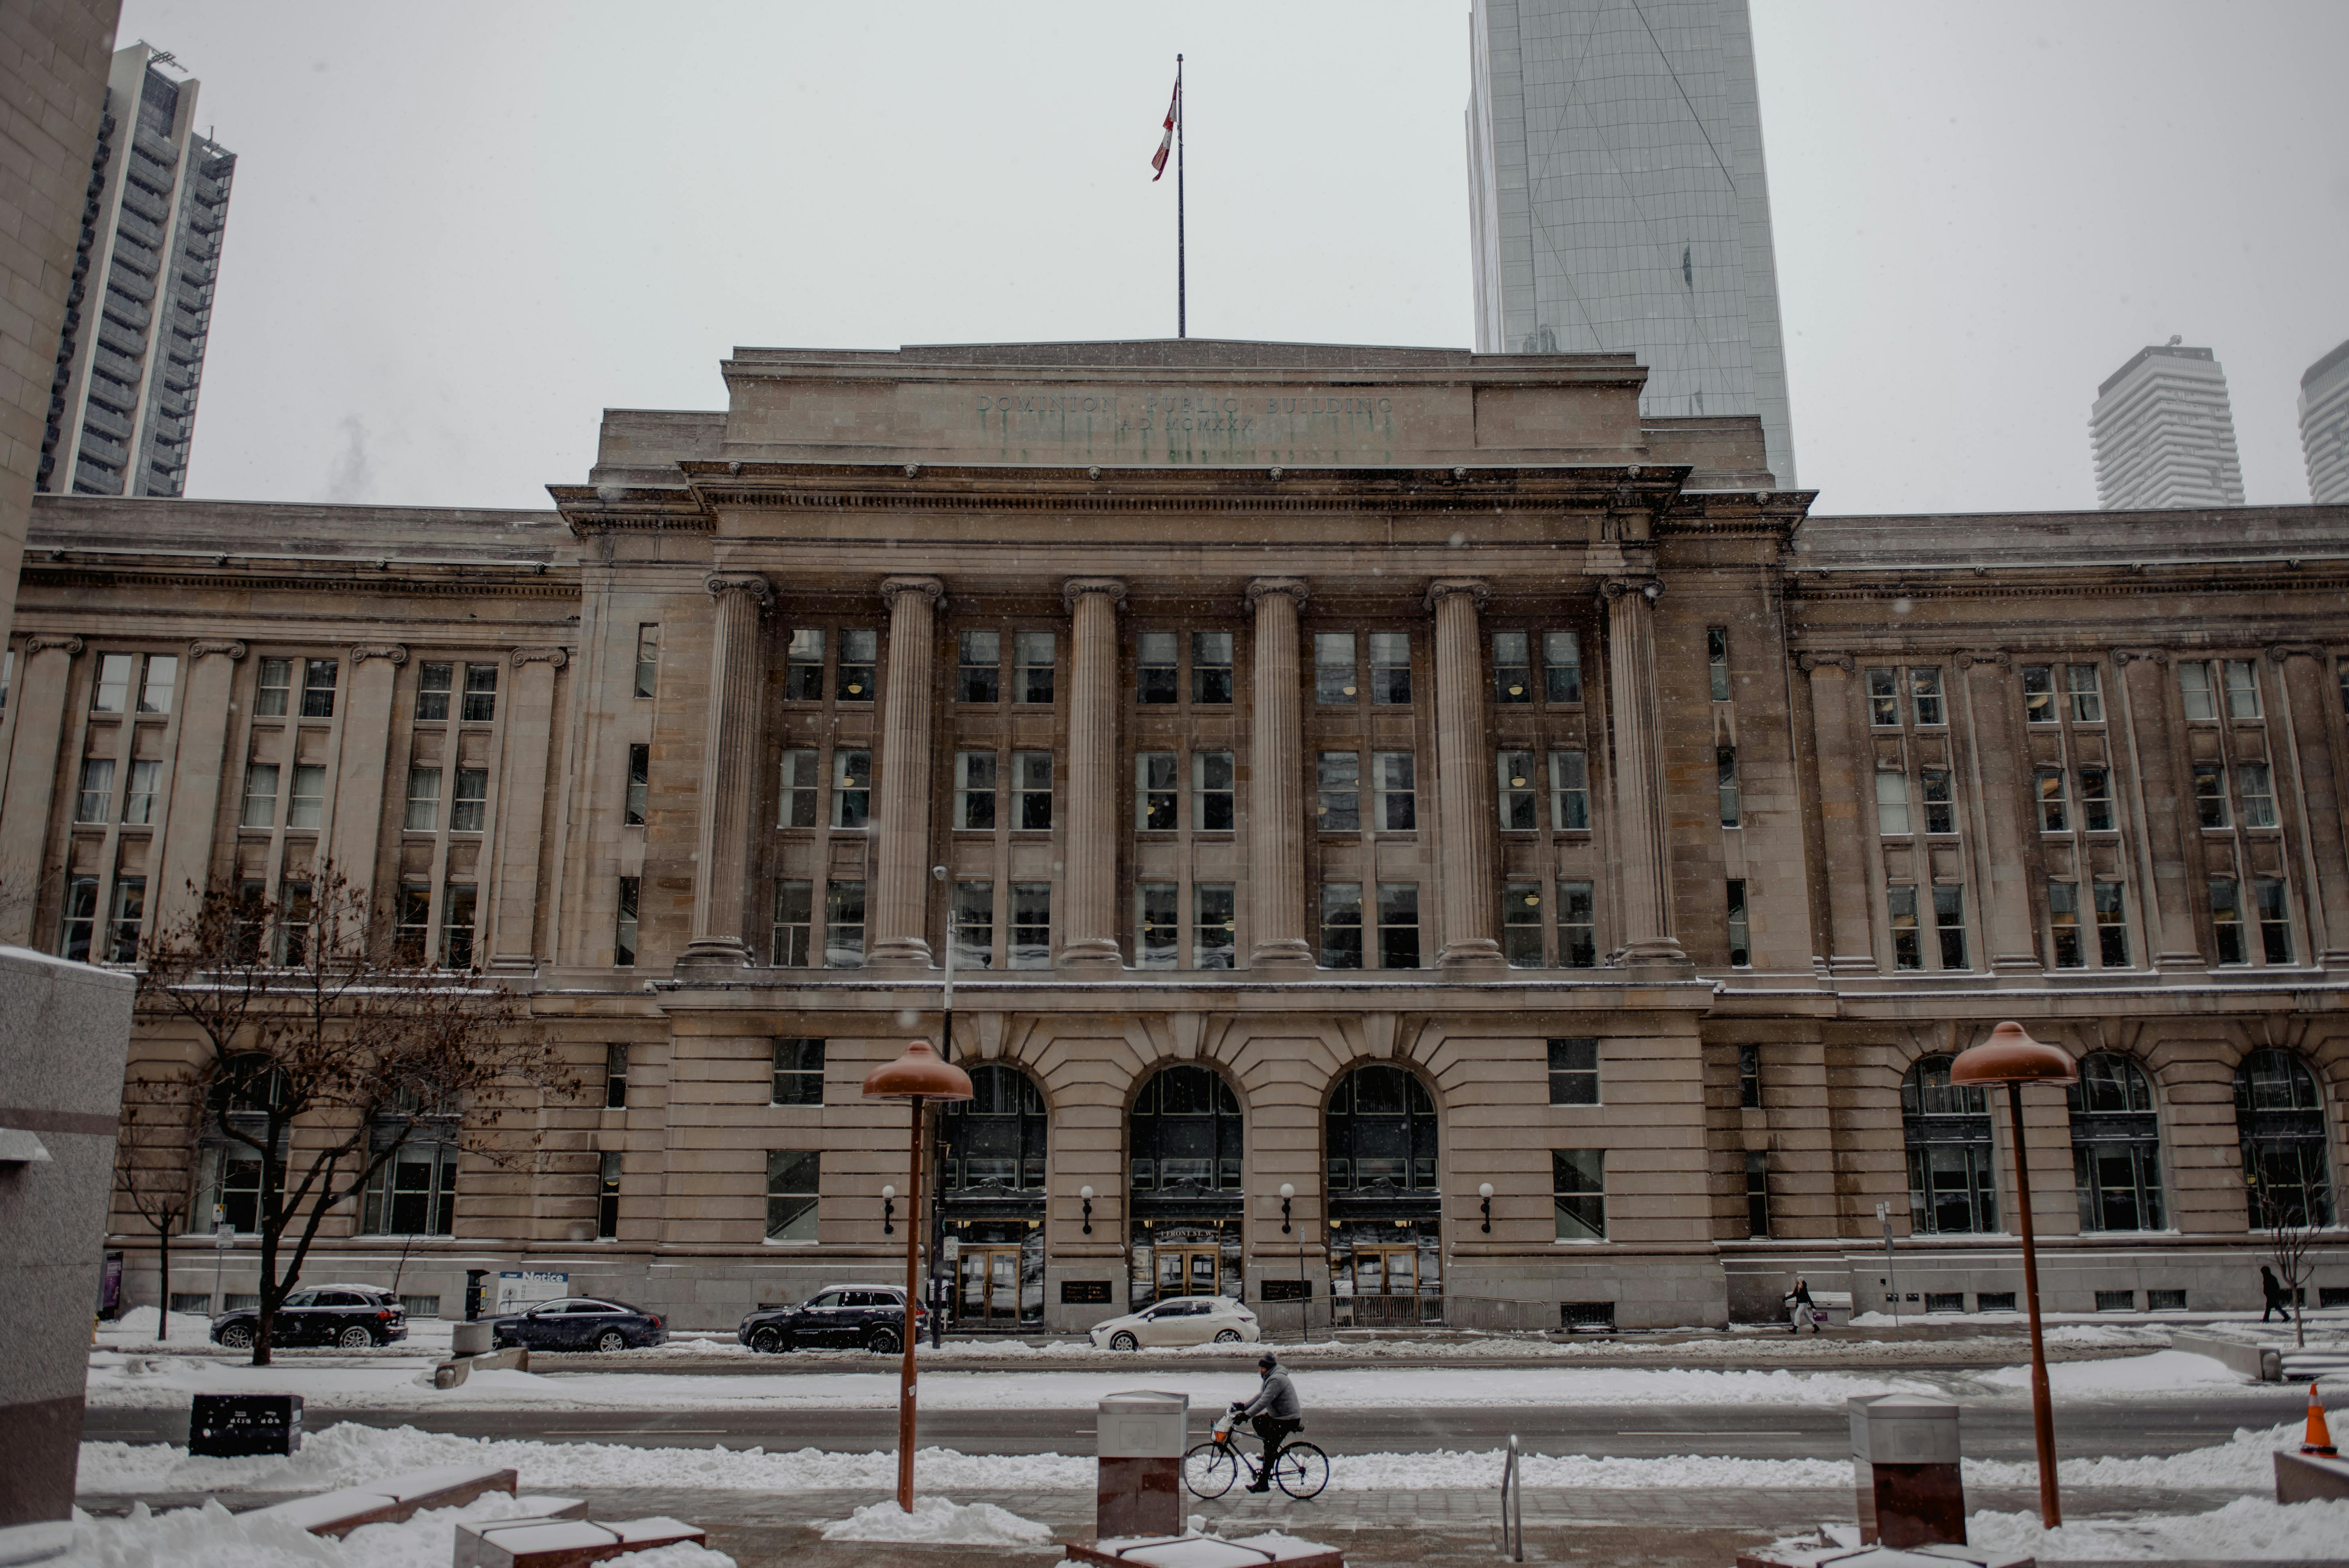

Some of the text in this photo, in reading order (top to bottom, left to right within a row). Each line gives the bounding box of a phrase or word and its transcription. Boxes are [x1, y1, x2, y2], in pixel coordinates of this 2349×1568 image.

[976, 395, 1392, 413] DOMINION PUBLIC BUILDING
[1165, 418, 1252, 430] MCMXXX
[522, 1271, 563, 1282] Notice
